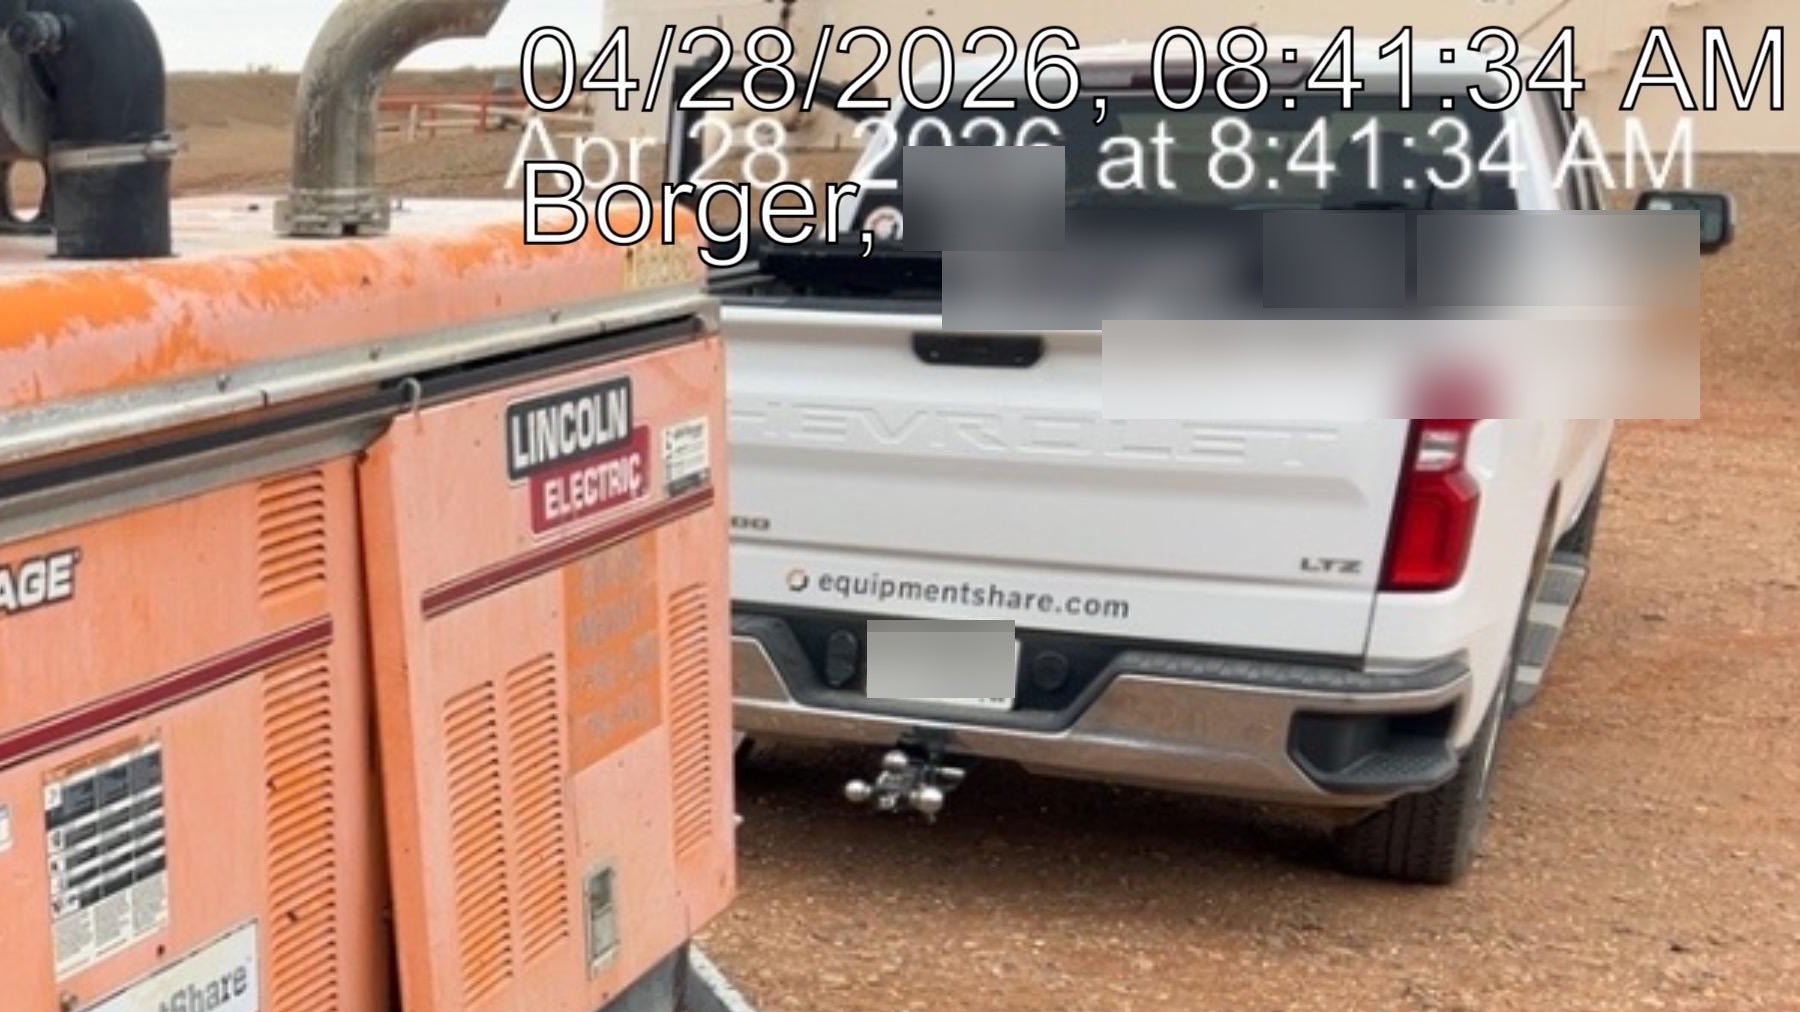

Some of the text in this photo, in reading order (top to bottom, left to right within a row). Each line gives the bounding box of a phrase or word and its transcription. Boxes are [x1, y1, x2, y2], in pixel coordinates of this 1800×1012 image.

[511, 387, 629, 468] LINCOLN
[730, 401, 1339, 465] HEVROLET
[544, 453, 641, 519] ELECTRIC
[817, 571, 1130, 619] equipmentshare.com
[1301, 557, 1363, 574] LTZ
